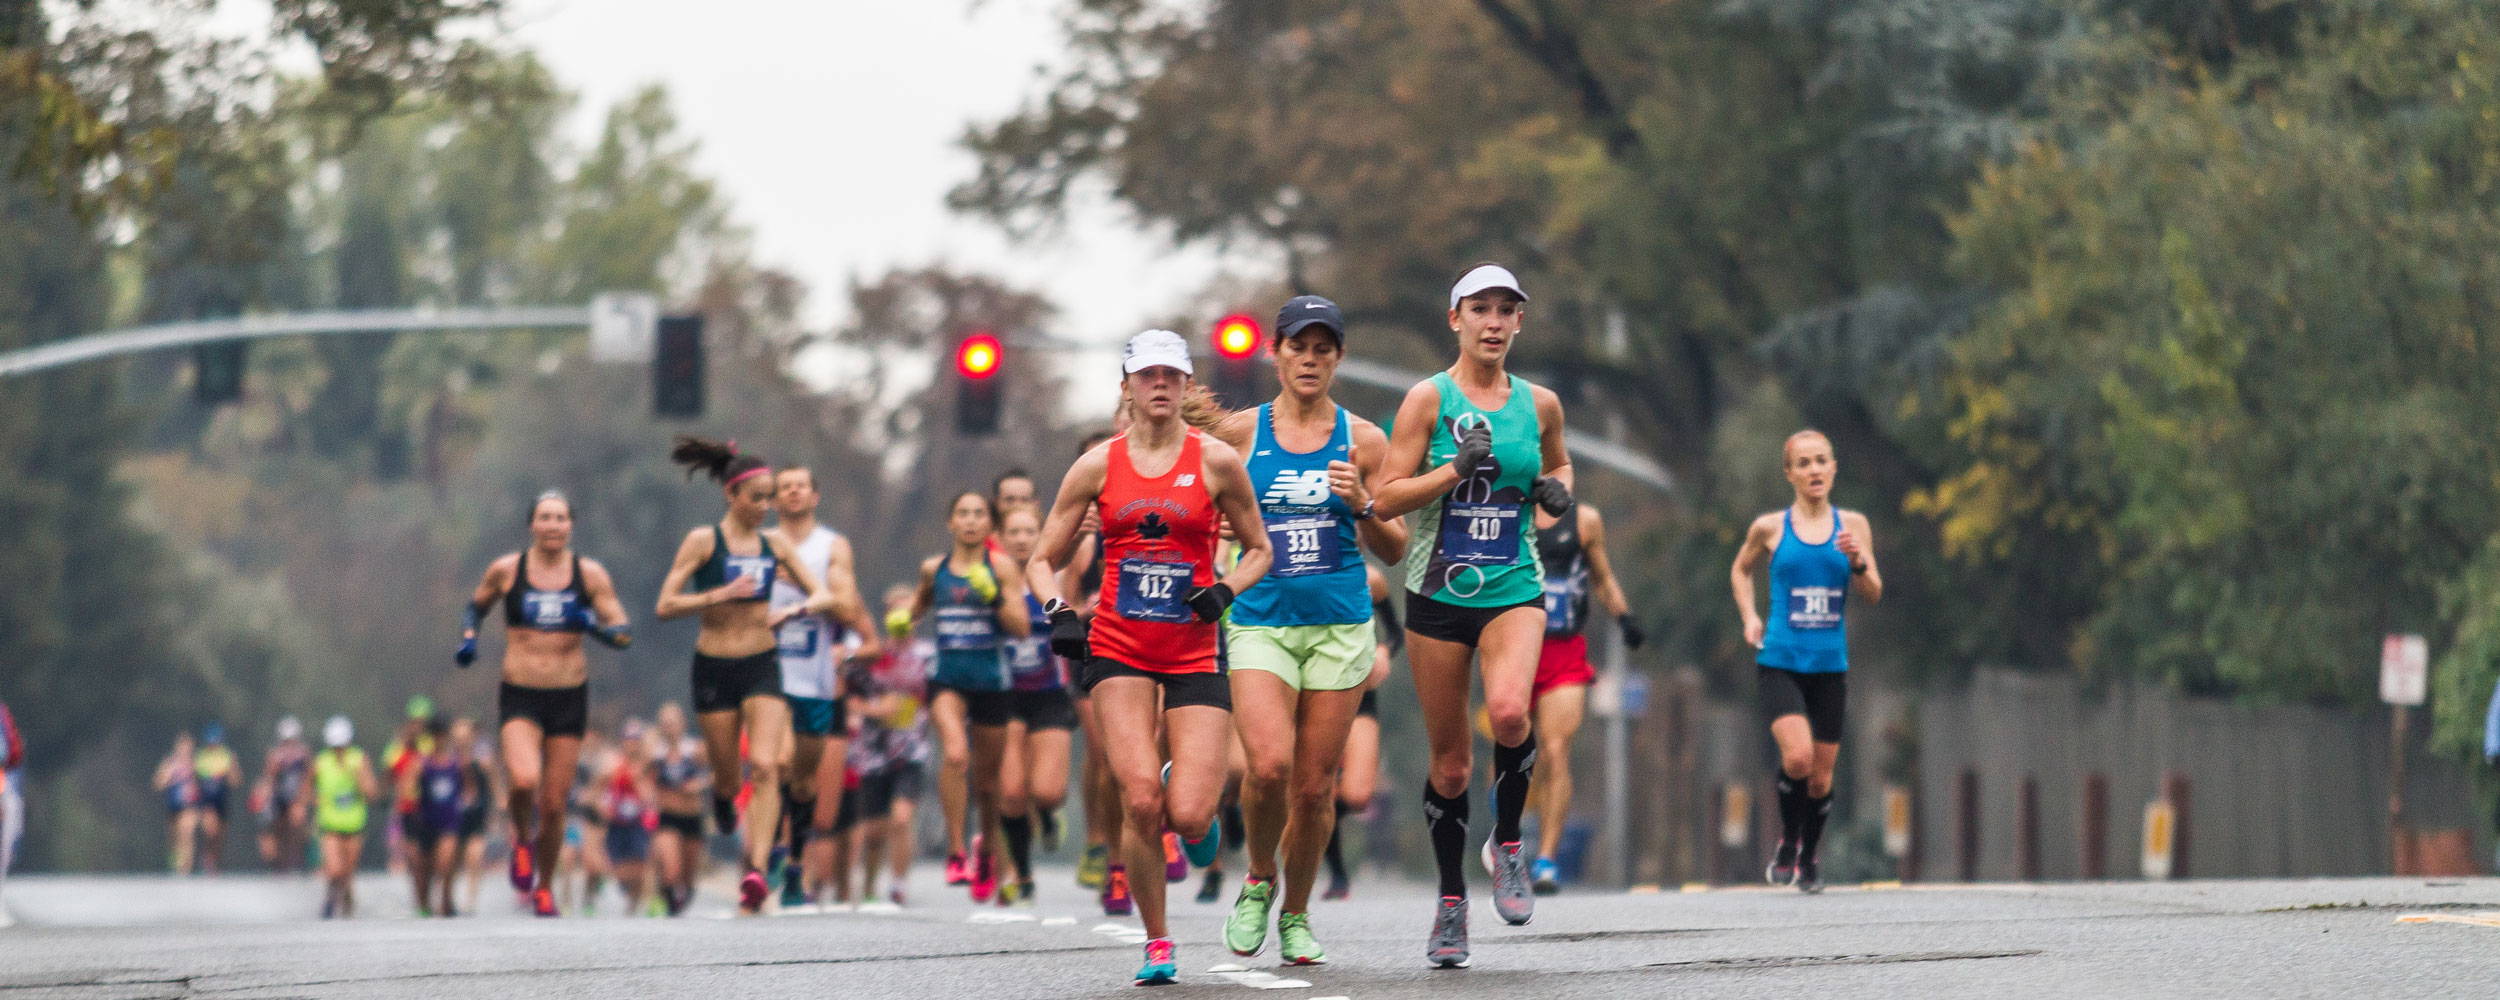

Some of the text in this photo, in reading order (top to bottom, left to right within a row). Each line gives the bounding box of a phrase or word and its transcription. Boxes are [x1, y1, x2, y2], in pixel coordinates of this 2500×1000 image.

[1261, 469, 1331, 505] NB
[1286, 528, 1321, 553] 331
[1467, 517, 1500, 541] 410
[1289, 552, 1320, 564] SAGE
[1138, 574, 1173, 599] 412
